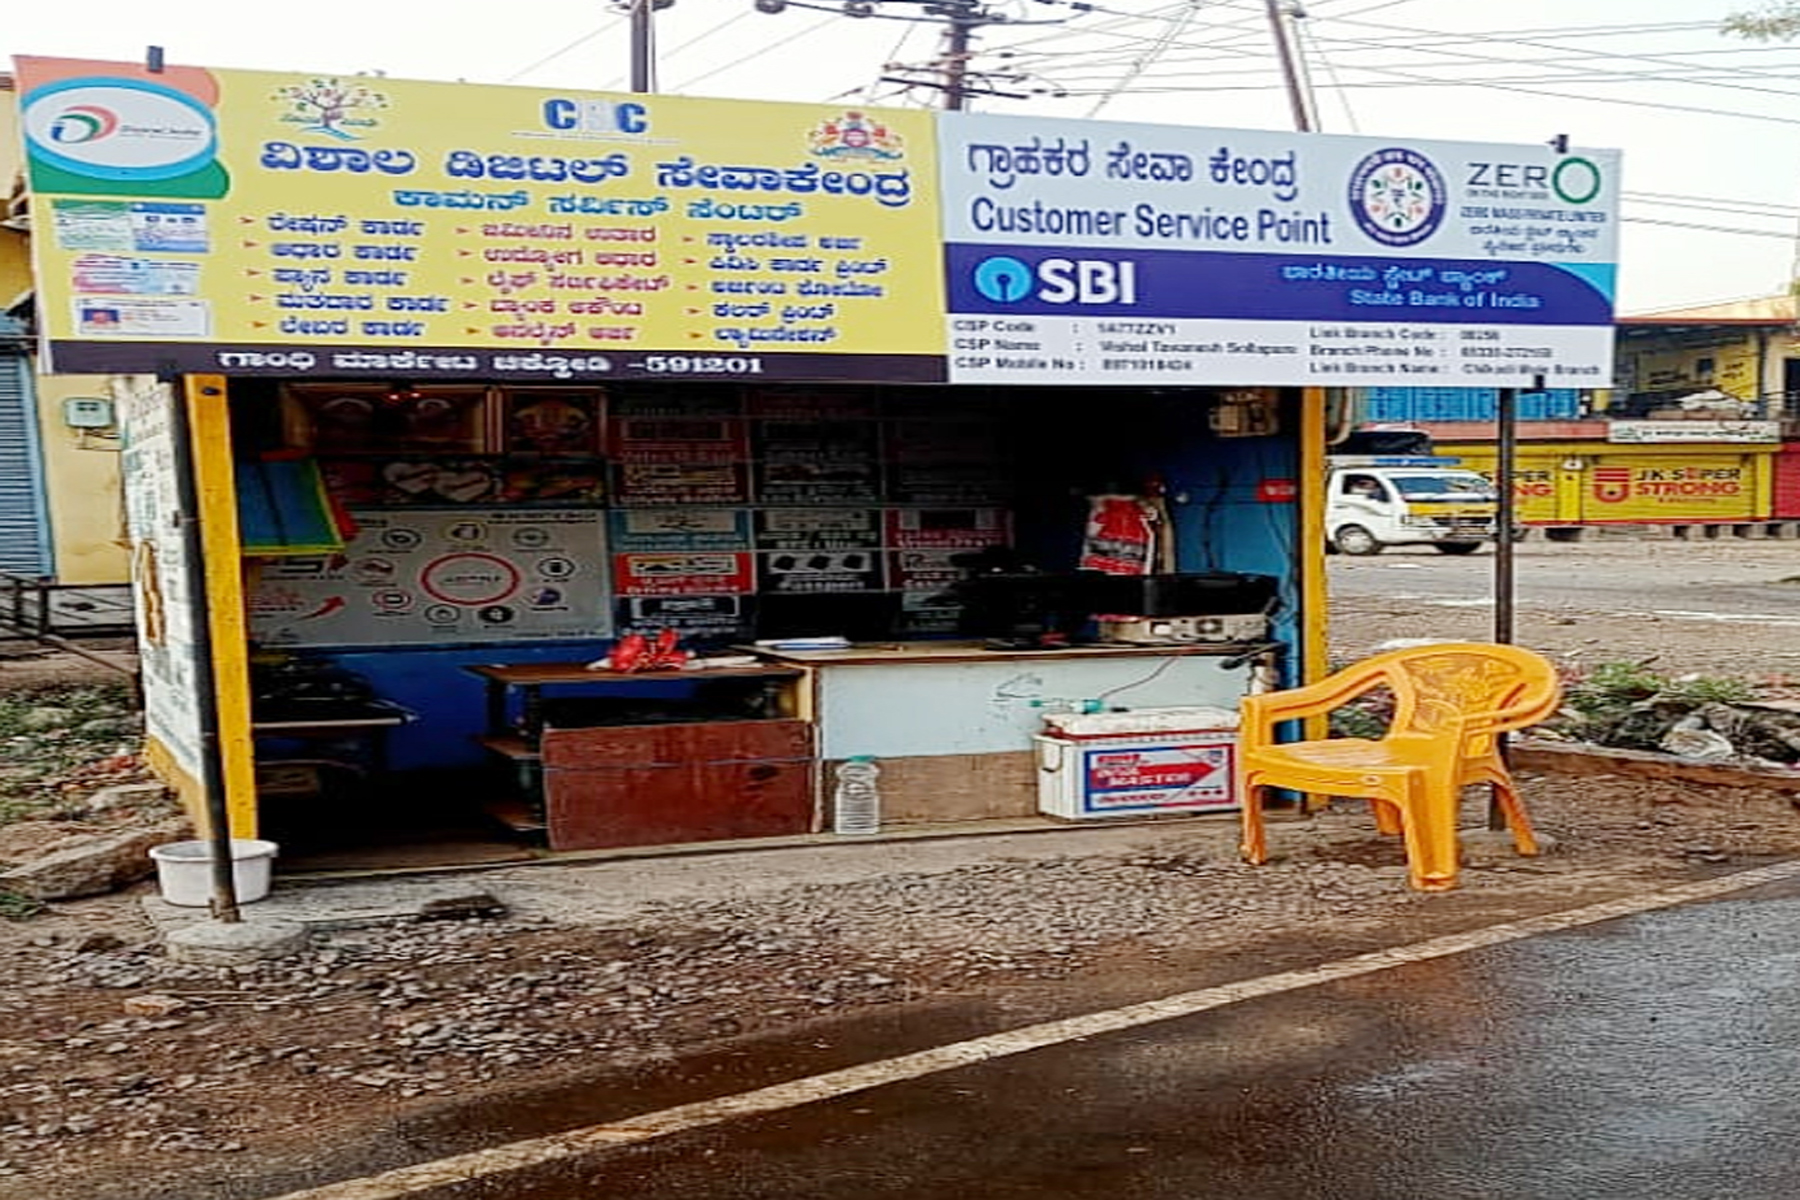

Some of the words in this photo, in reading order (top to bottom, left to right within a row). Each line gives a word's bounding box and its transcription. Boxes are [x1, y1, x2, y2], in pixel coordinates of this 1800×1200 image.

[544, 99, 647, 133] CC
[260, 141, 414, 175] ವಿಶಾಲ
[967, 137, 1090, 189] ಗ್ರಾಹಕರ
[1106, 141, 1193, 182] ಸೇವಾ
[1209, 147, 1298, 201] ಕೇಂದ್ರ
[1467, 157, 1601, 204] ZERO
[395, 189, 528, 211] ಕಾಮನ್
[971, 196, 1126, 236] Customer
[1134, 203, 1249, 240] Service
[1257, 209, 1332, 244] Point
[1037, 258, 1137, 304] SBI
[1350, 289, 1403, 306] State
[1408, 290, 1460, 307] Bank
[1463, 291, 1483, 308] of
[1490, 291, 1541, 308] India
[954, 319, 987, 332] CSP
[993, 320, 1036, 333] Code
[1347, 328, 1396, 341] Branch
[954, 337, 990, 351] CSP
[994, 338, 1042, 352] Name
[218, 348, 315, 370] ಗಾಂಧಿ
[954, 355, 990, 369] CSP
[995, 356, 1048, 370] Mobile
[1052, 357, 1075, 371] No
[1347, 363, 1396, 376] Branch
[1635, 482, 1741, 496] STRONG
